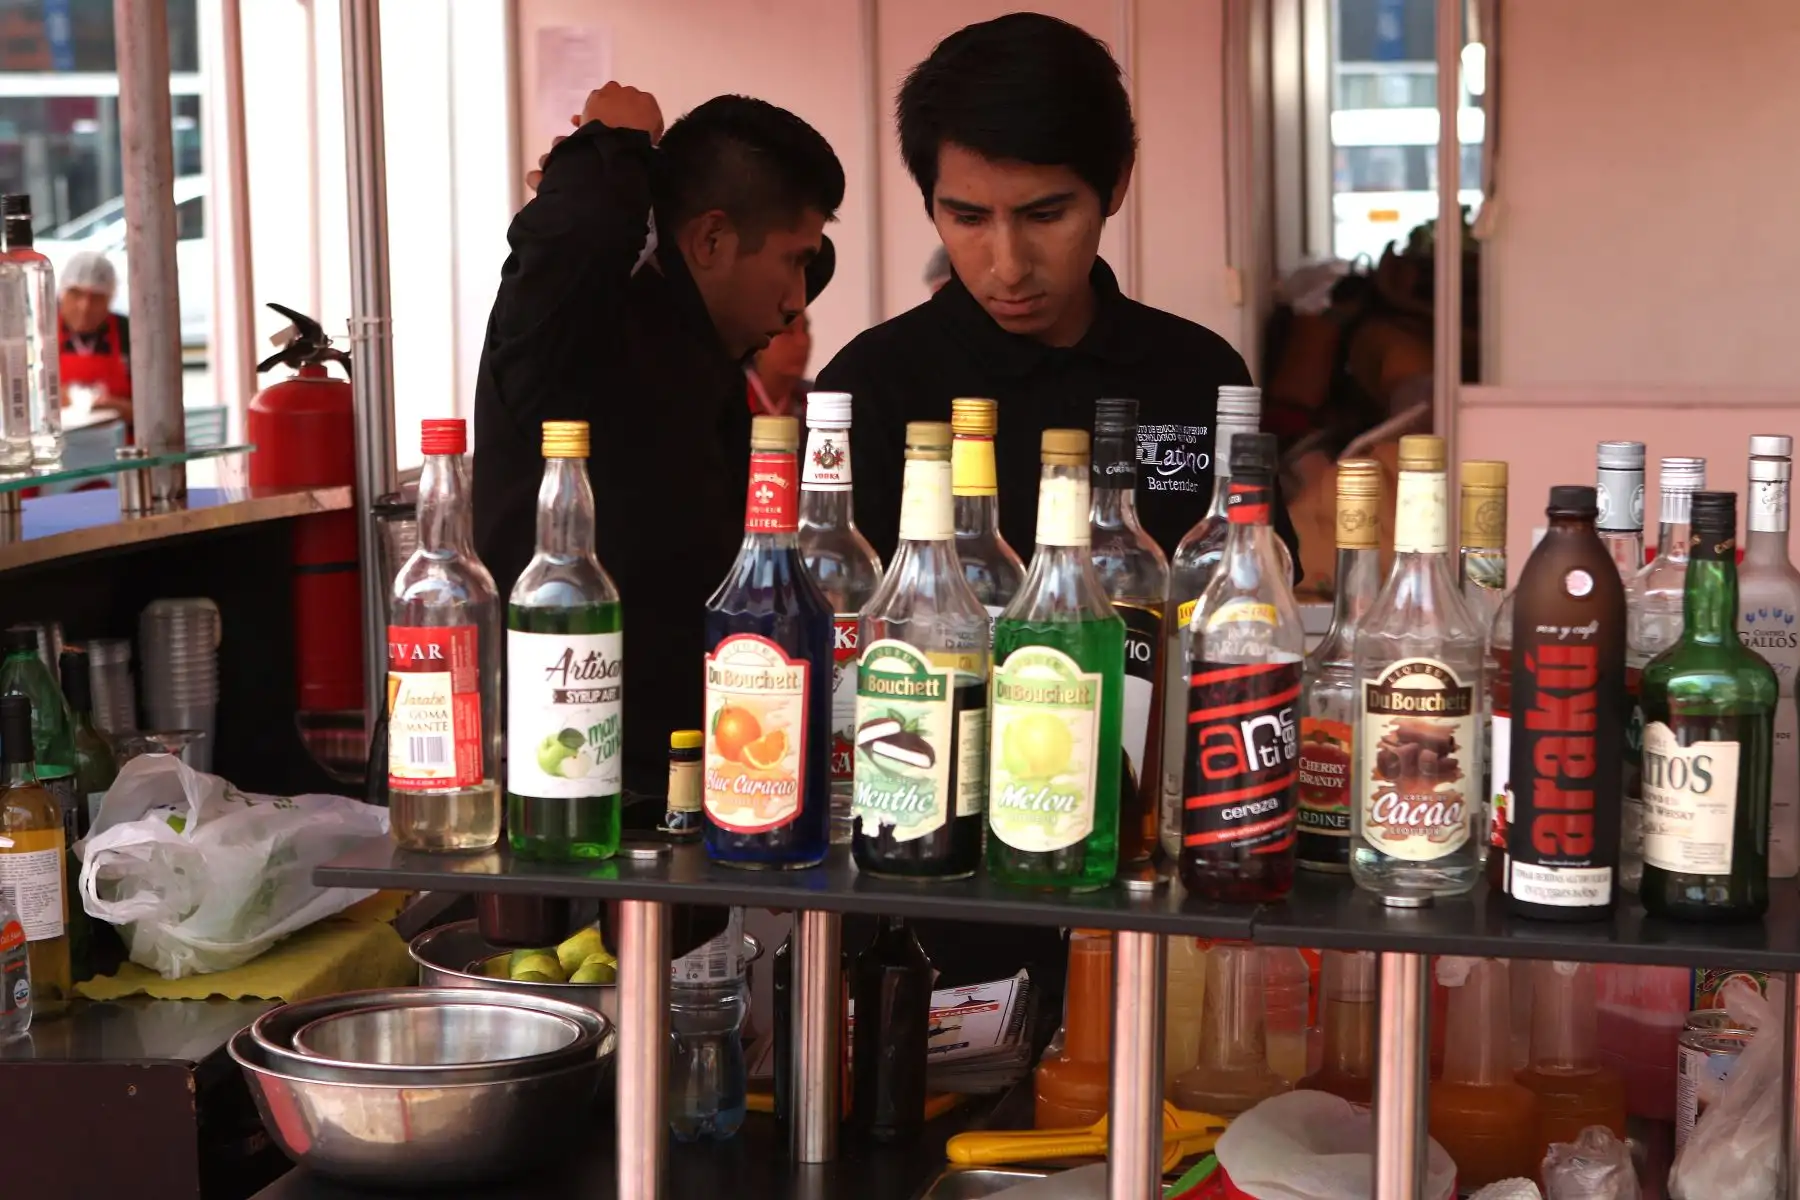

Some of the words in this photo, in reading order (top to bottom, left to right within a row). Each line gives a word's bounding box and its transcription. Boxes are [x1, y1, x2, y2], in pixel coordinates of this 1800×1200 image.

[1147, 476, 1199, 493] Bartender
[1738, 631, 1798, 648] GALLOS
[722, 668, 800, 690] Bouchett
[867, 674, 940, 697] Bouchett
[1523, 644, 1599, 856] arakú
[1298, 756, 1346, 775] CHERRY
[1299, 770, 1345, 789] BRANDY
[1000, 783, 1076, 812] Melon
[1221, 797, 1279, 820] cereza
[1372, 791, 1463, 827] Cacao
